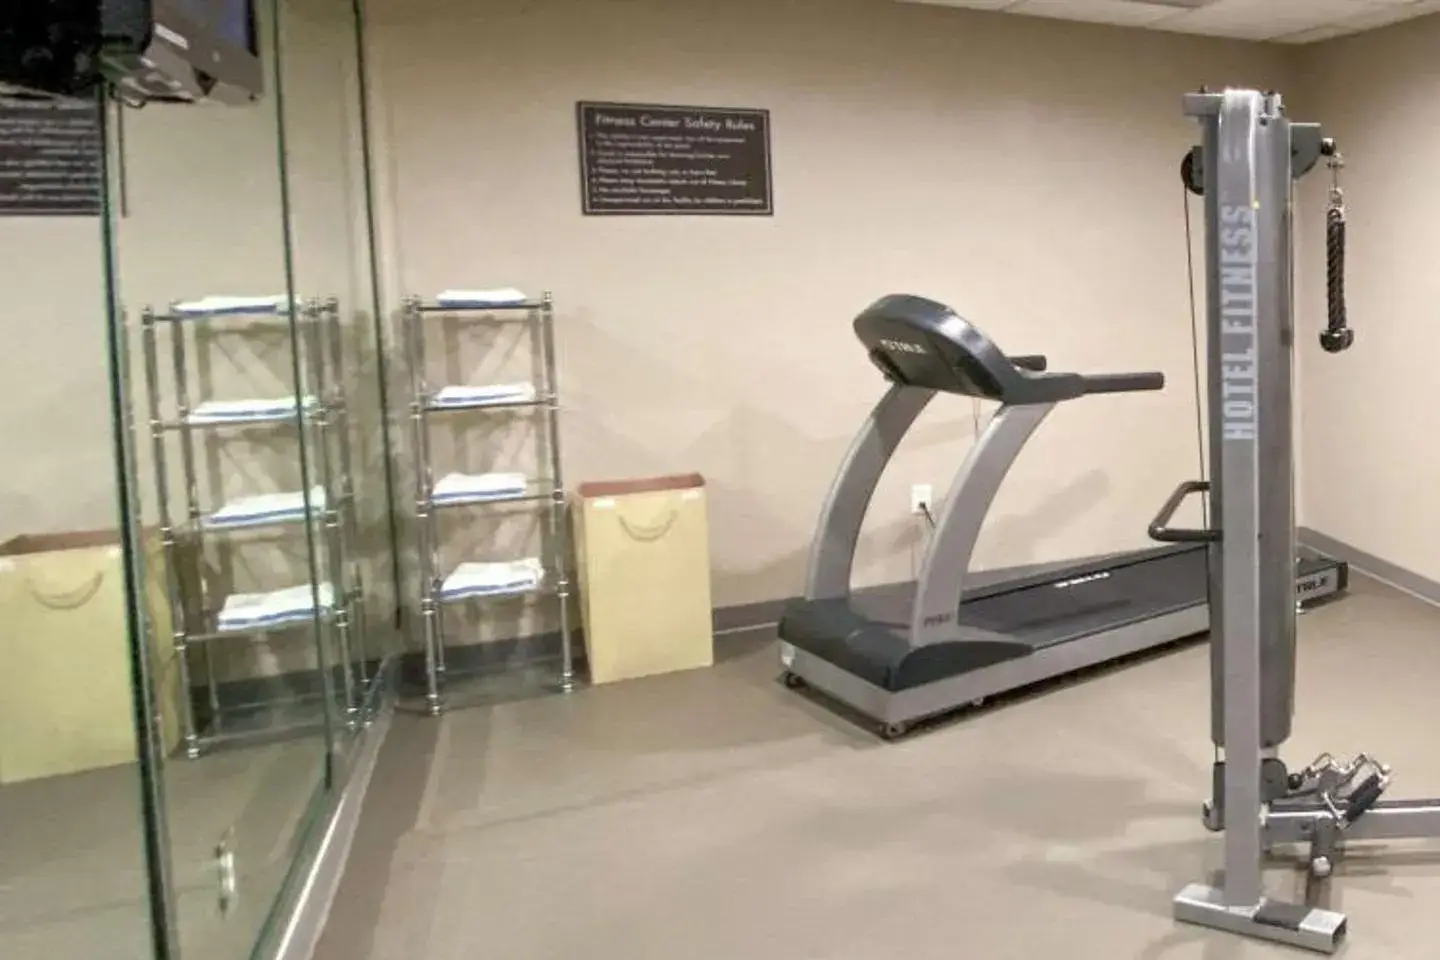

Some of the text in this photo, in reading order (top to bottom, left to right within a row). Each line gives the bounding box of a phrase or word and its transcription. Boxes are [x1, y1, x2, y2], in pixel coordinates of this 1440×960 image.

[595, 113, 756, 131] Fitness Center Safety Rules
[1221, 204, 1255, 440] HOTEL FITNESS
